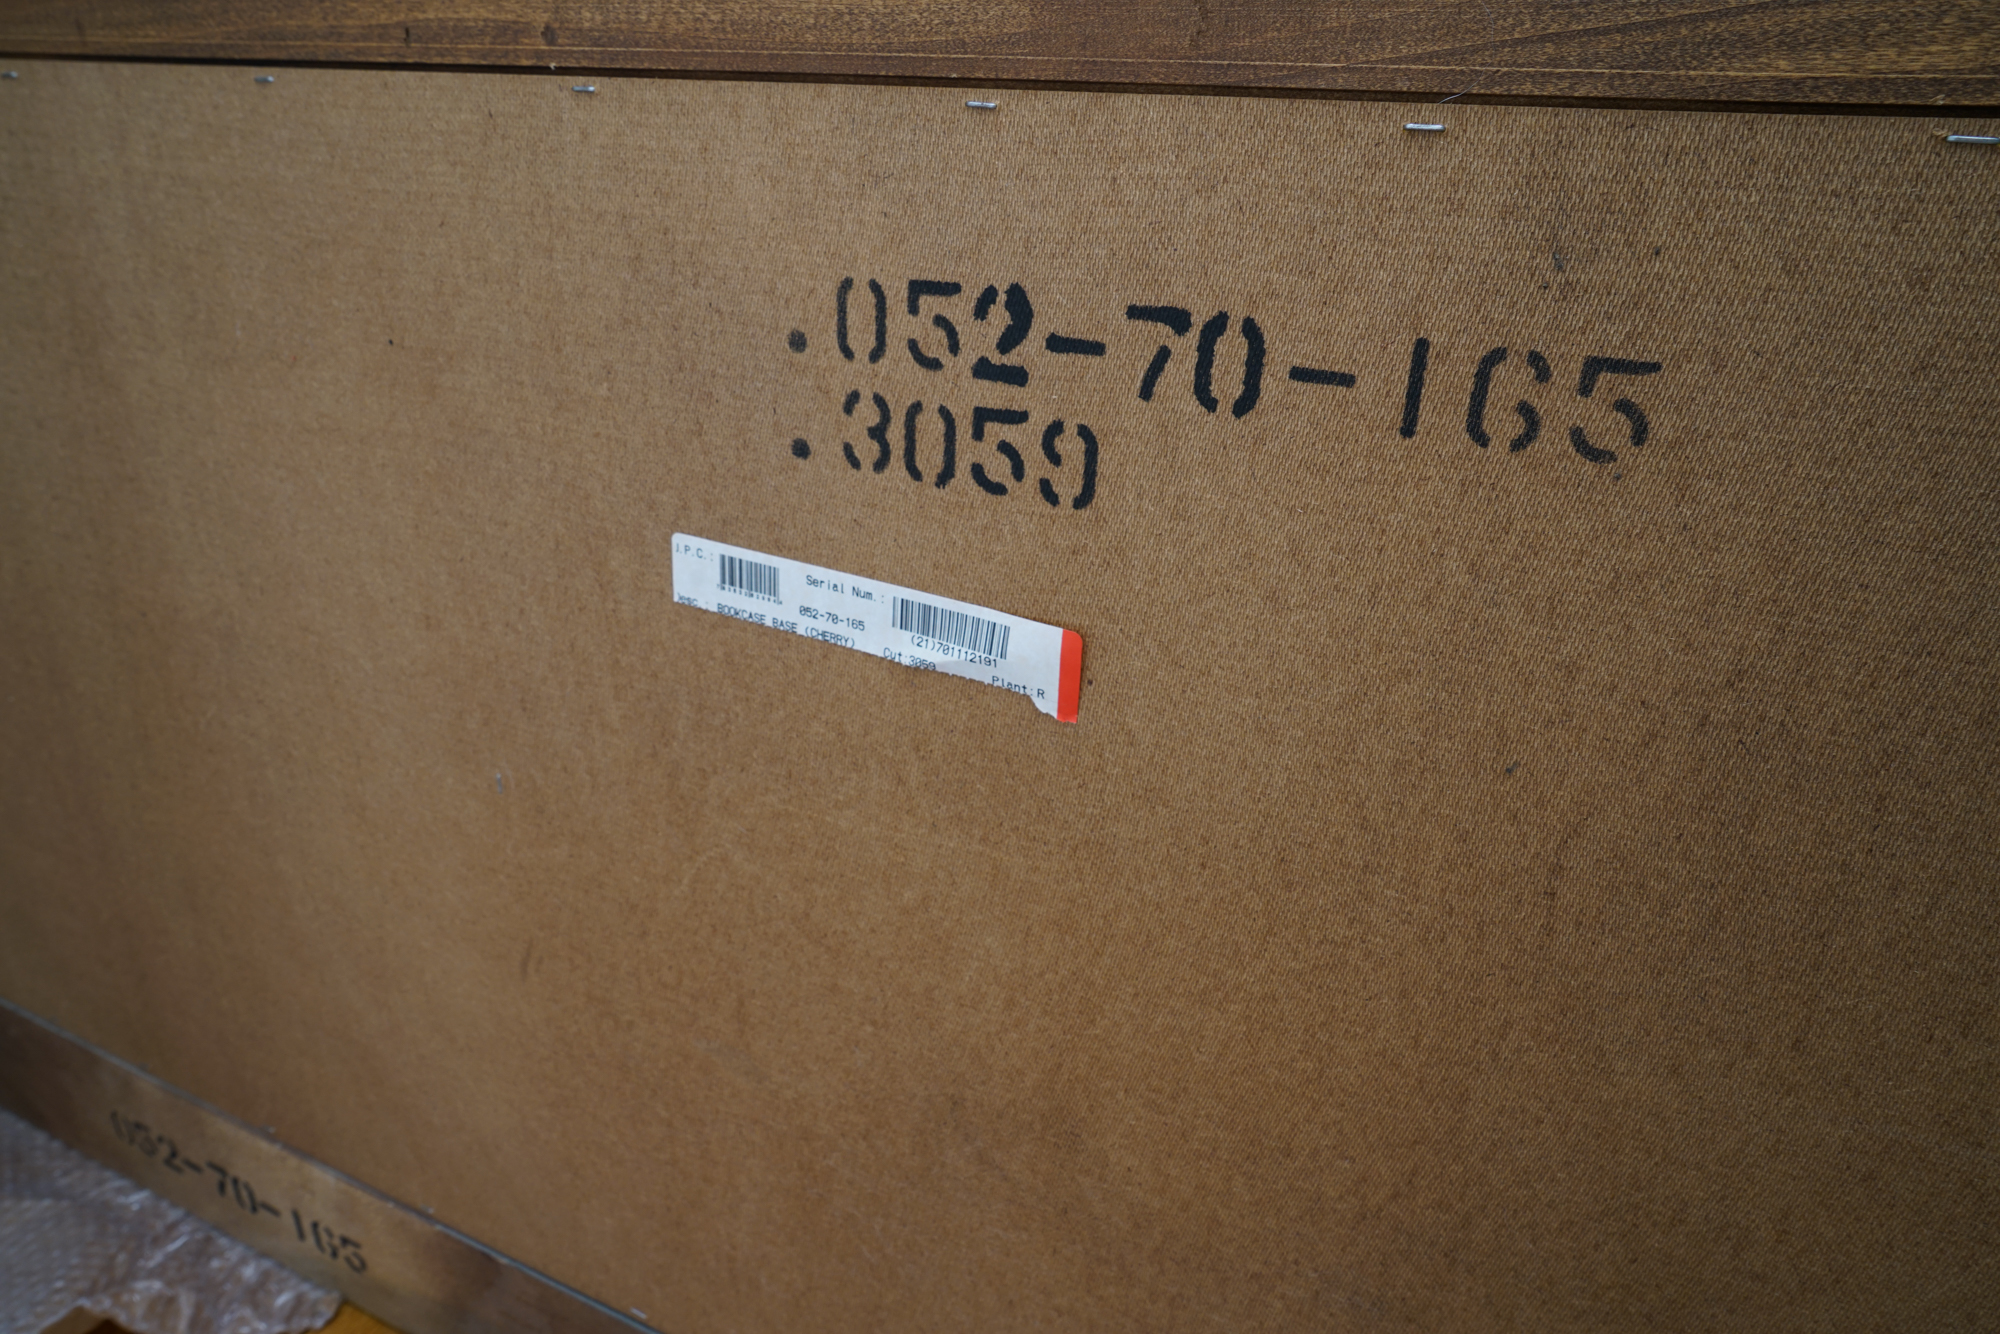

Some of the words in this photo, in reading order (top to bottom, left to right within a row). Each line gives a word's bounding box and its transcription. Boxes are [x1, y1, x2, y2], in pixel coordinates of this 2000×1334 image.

[805, 574, 845, 594] Serial
[717, 602, 767, 625] BOOKCASE
[772, 617, 798, 634] BASE
[805, 626, 856, 649] (CHERRY)
[799, 605, 866, 632] 052-70-165
[911, 634, 998, 669] (21)701112191
[110, 1110, 367, 1275] 052-70-165
